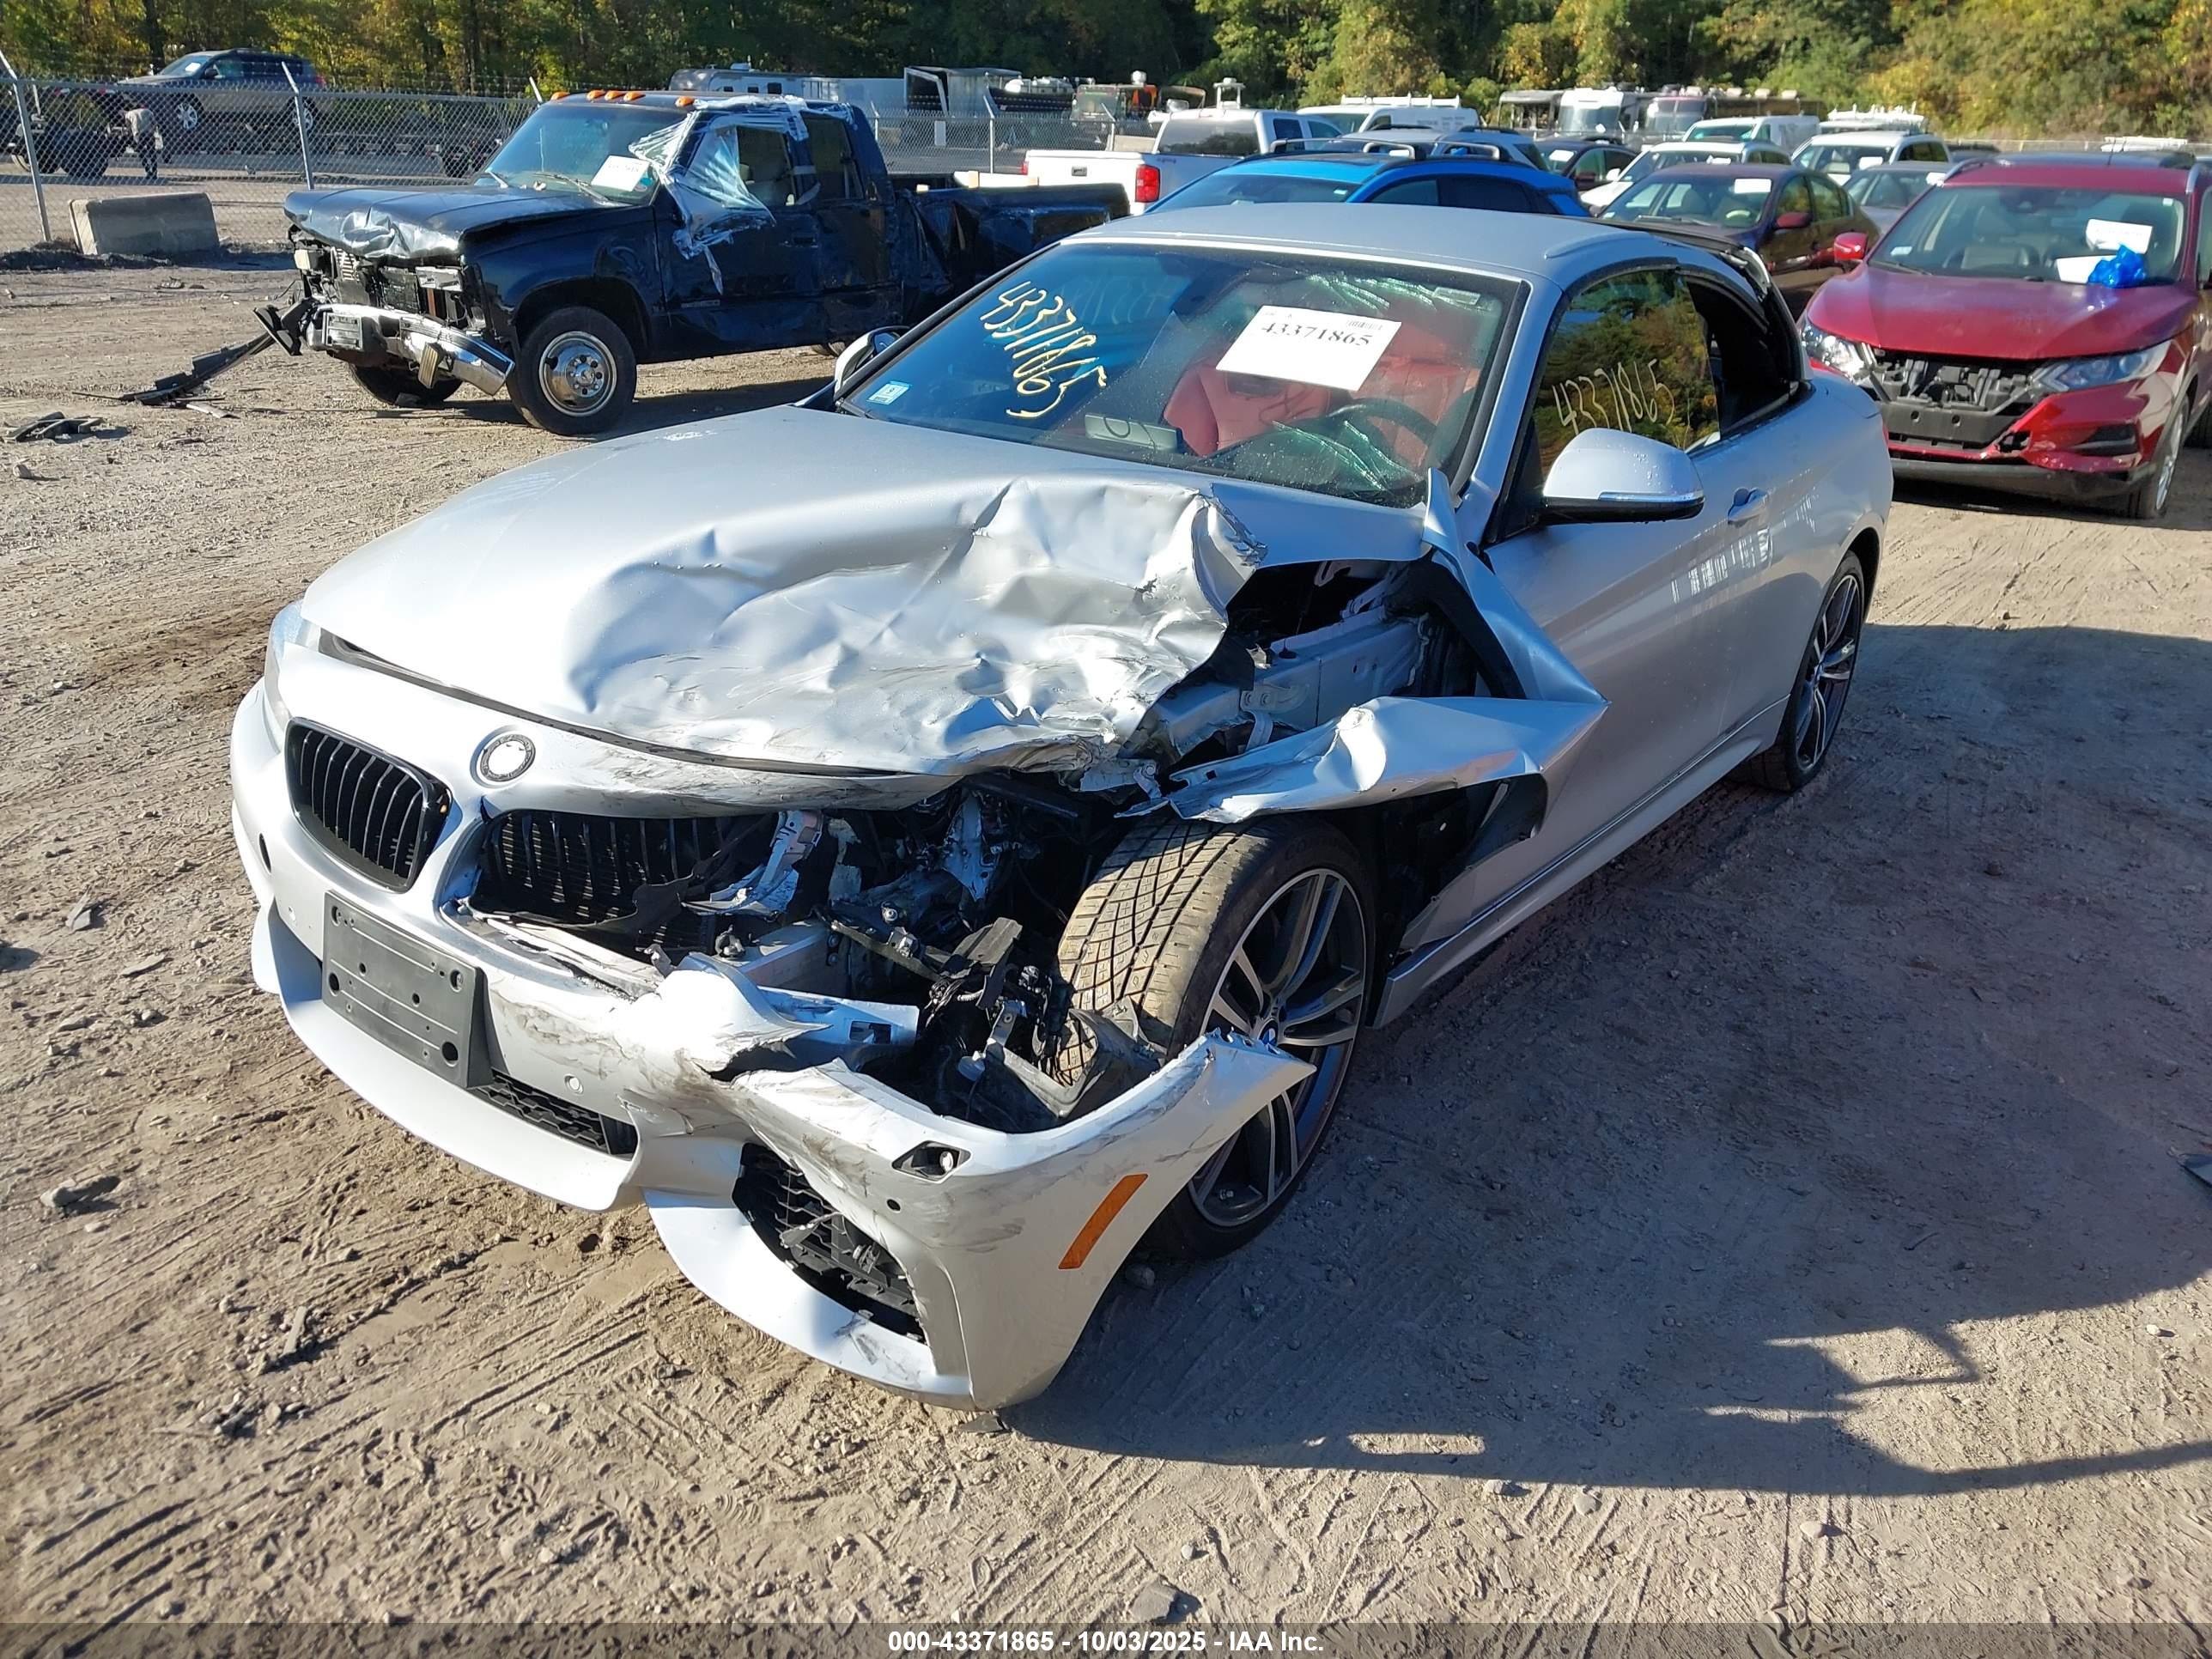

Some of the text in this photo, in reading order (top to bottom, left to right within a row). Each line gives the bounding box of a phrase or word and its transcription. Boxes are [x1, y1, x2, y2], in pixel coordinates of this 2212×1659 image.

[979, 281, 1108, 418] 43371865
[1261, 322, 1373, 346] 43371865
[1552, 358, 1675, 436] 43371865
